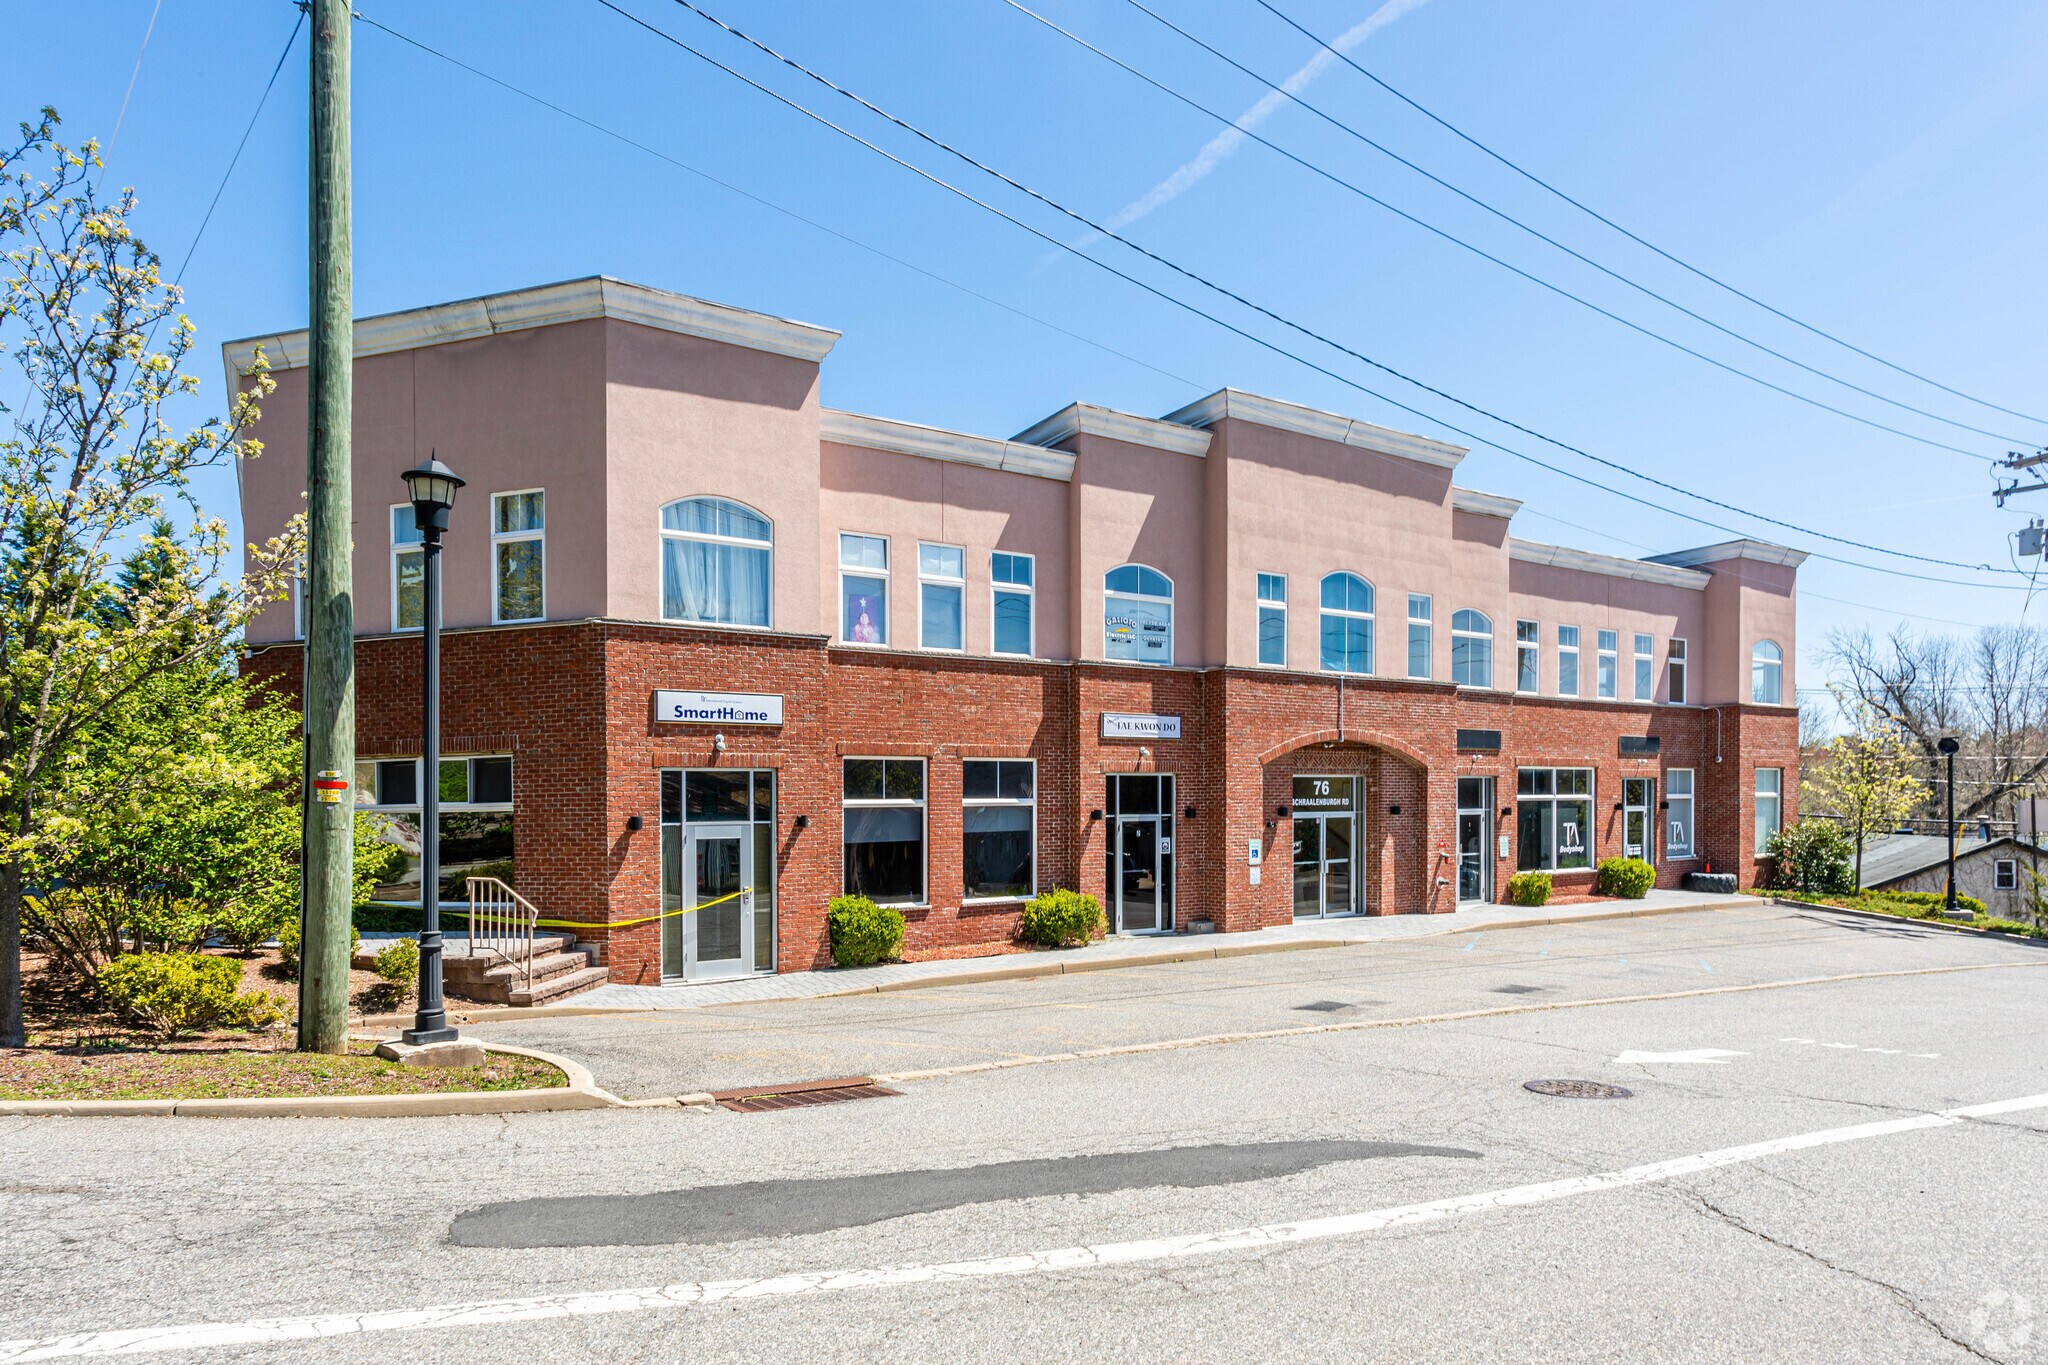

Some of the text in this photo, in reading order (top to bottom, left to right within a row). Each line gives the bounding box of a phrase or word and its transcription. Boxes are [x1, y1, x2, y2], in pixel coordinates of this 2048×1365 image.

[1106, 616, 1137, 629] GALIOTO
[1134, 722, 1161, 731] KWON
[1163, 723, 1176, 731] DO
[1313, 780, 1330, 796] 76
[1342, 798, 1349, 806] RD
[1559, 845, 1584, 854] Bodyshop
[1667, 842, 1688, 851] Bodyshop
